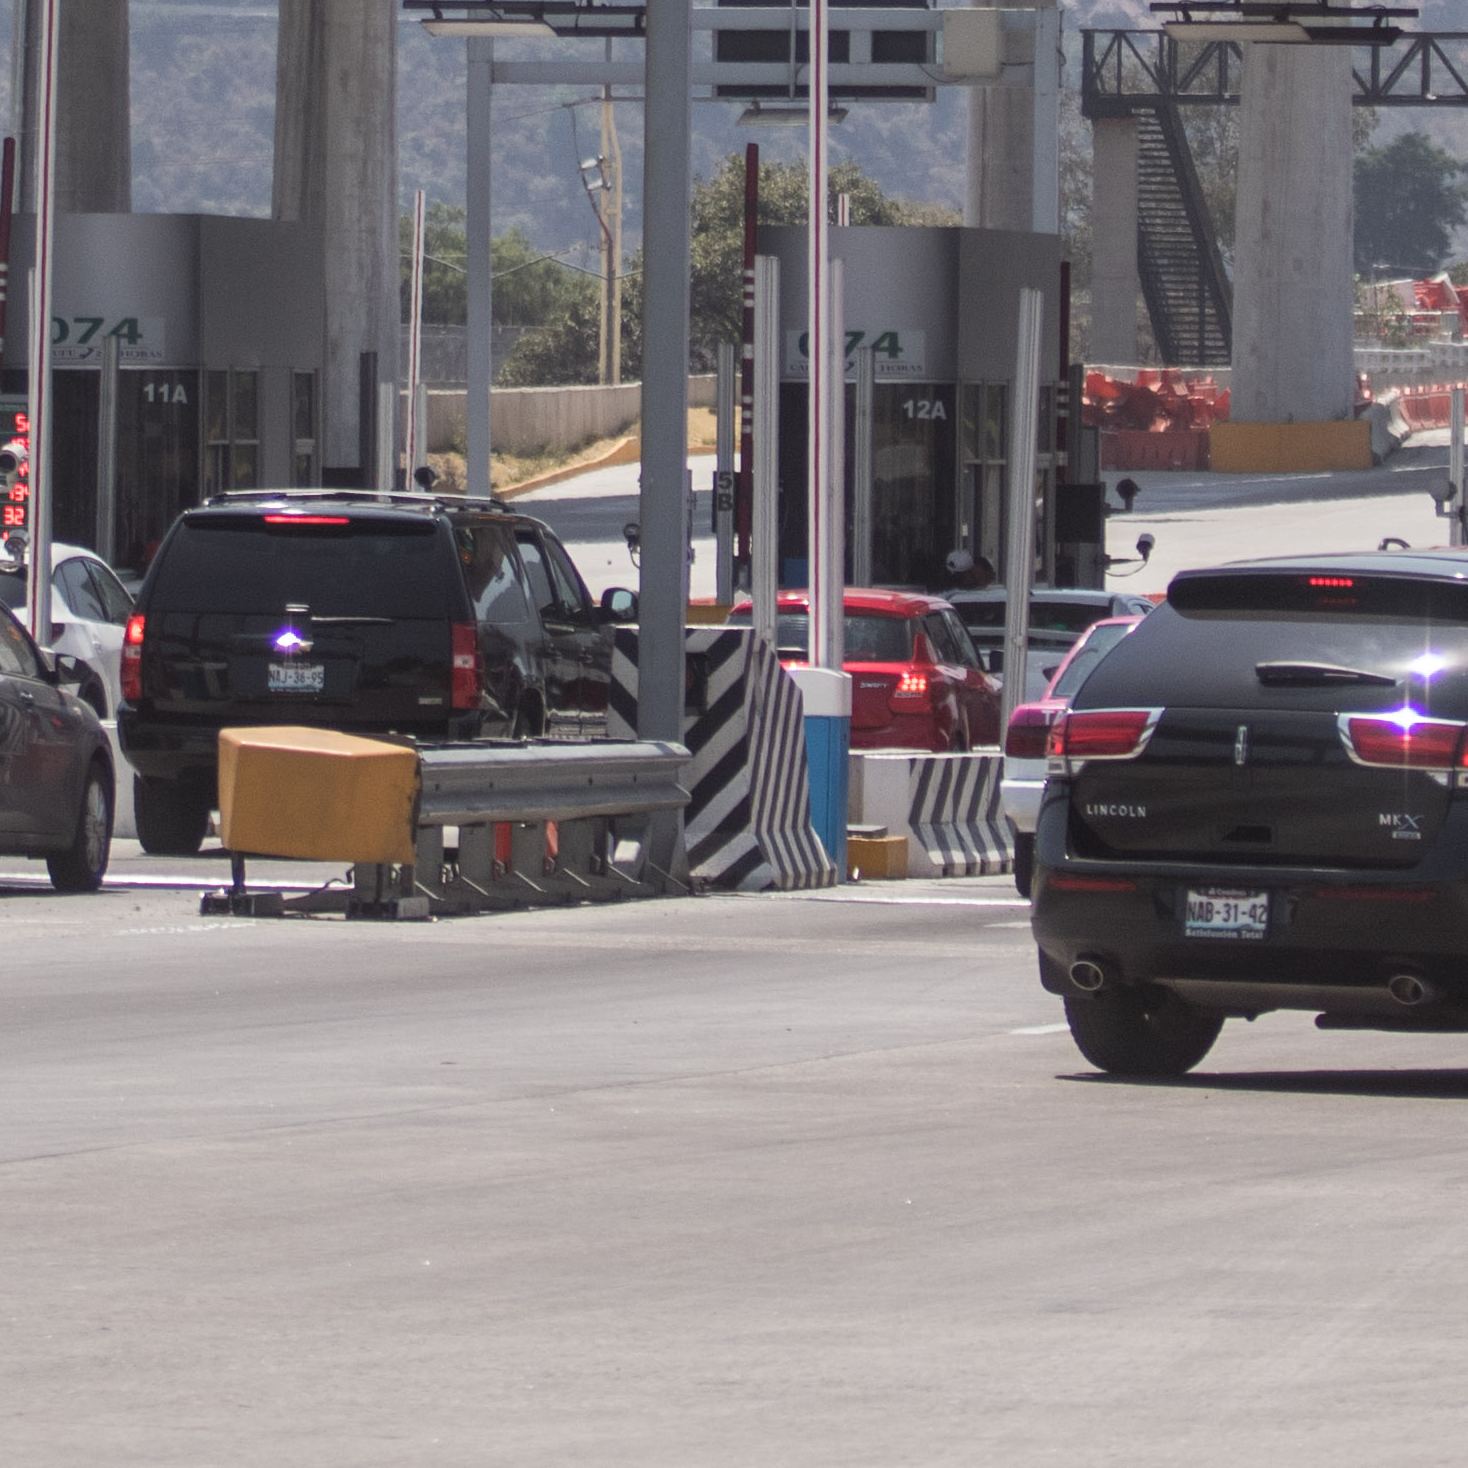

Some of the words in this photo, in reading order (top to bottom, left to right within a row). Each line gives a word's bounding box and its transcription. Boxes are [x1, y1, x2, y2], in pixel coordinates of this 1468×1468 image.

[143, 383, 188, 404] 11A
[903, 400, 947, 420] 12A
[1085, 804, 1147, 818] LINCOLN
[1379, 813, 1425, 831] MKX
[1187, 901, 1267, 924] NAB-31-42
